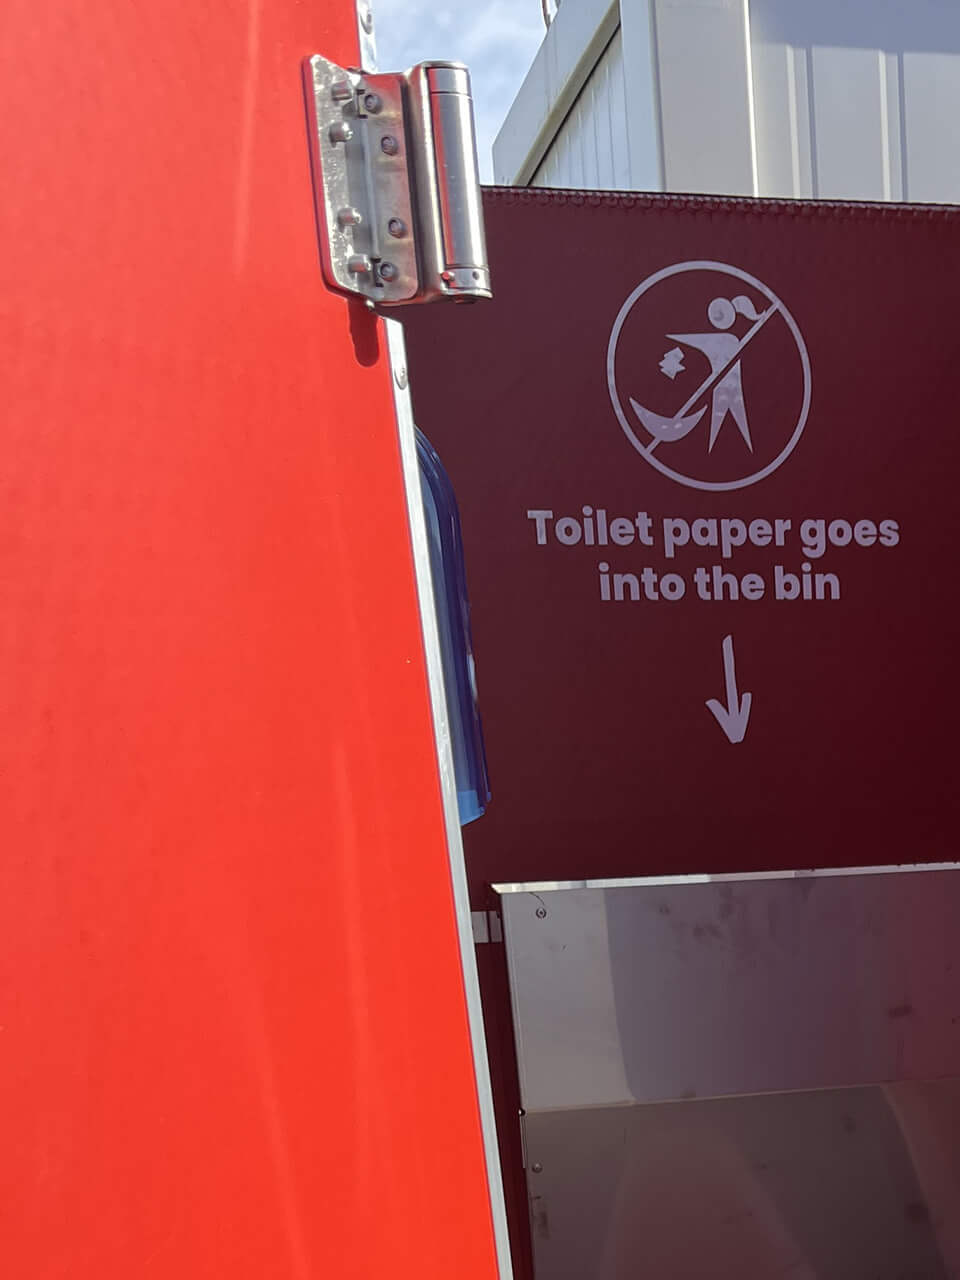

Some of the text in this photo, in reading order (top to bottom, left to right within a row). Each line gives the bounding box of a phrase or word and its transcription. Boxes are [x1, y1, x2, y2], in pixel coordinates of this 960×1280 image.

[526, 505, 900, 559] Toilet paper goes
[598, 562, 841, 602] into the bin
